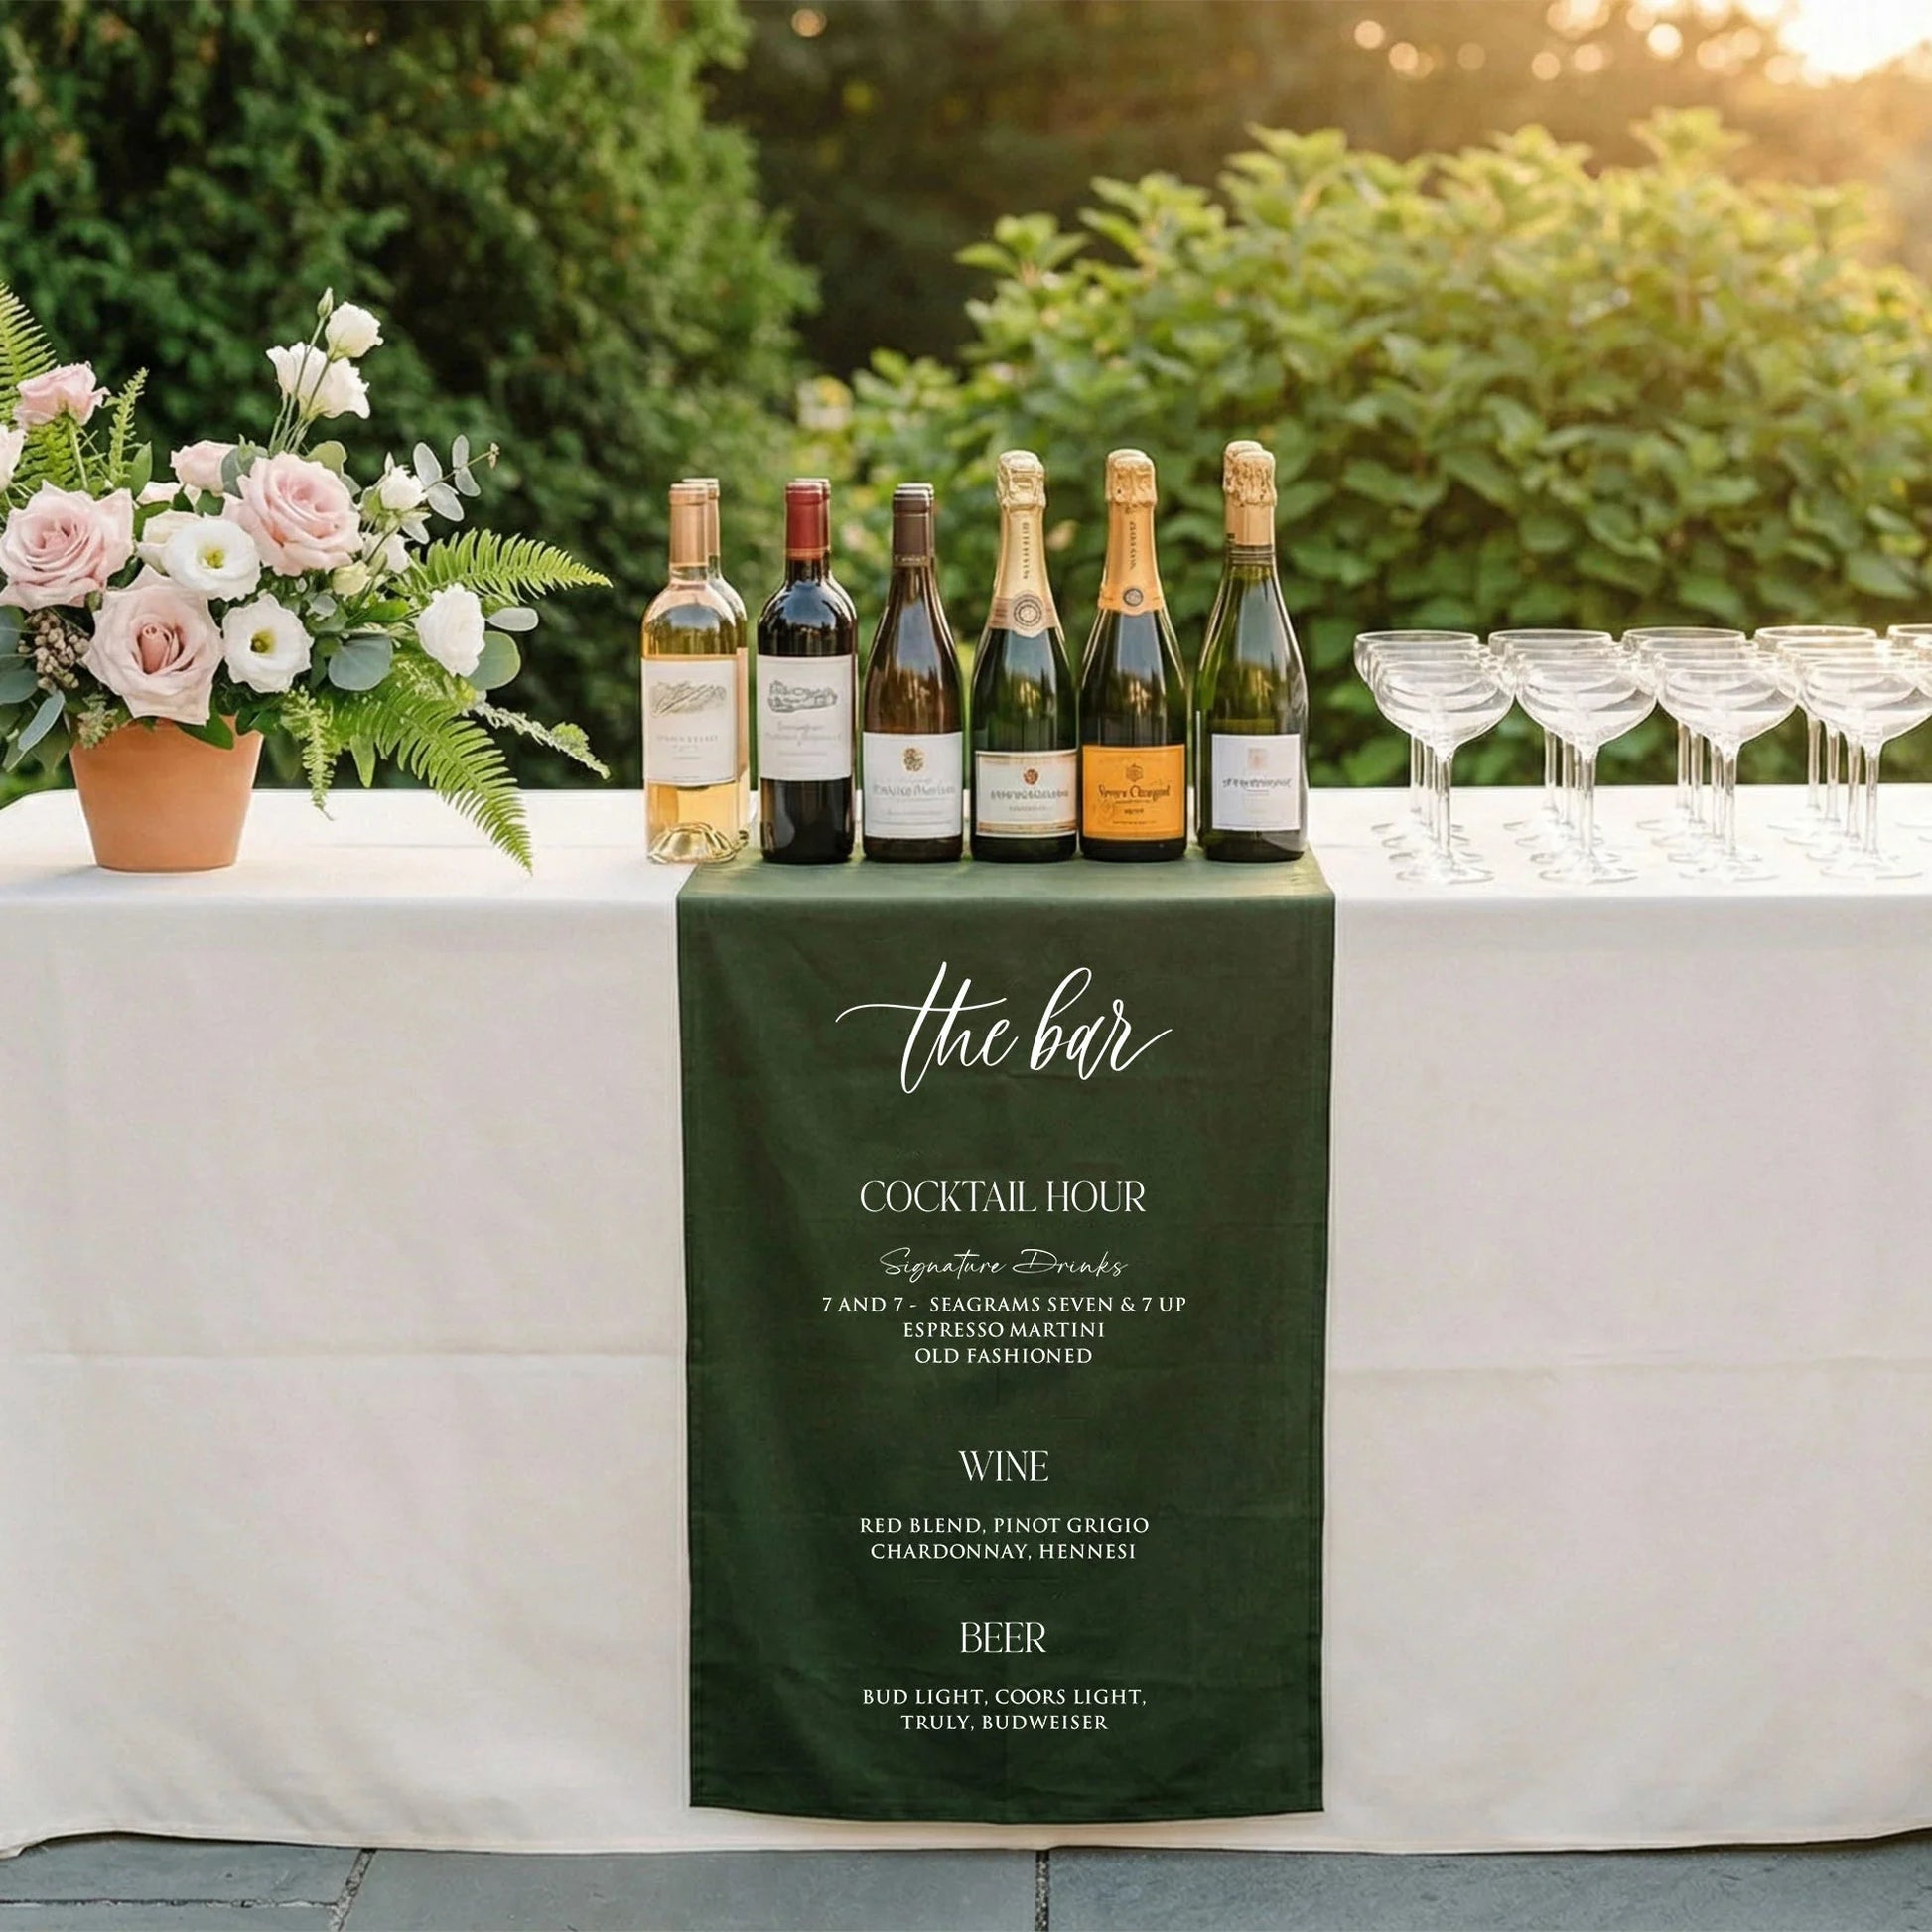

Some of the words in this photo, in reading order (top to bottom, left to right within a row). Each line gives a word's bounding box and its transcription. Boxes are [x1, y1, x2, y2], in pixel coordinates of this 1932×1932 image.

[835, 961, 1019, 1094] the
[1030, 967, 1173, 1080] bar
[861, 1181, 1036, 1212] COCKTAIL
[1047, 1181, 1146, 1212] HOUR
[880, 1247, 1007, 1283] Signature
[1013, 1249, 1129, 1278] Drinks
[822, 1297, 832, 1311] 7
[838, 1297, 886, 1311] AND
[894, 1297, 903, 1311] 7
[929, 1297, 1039, 1311] SEAGRAMS
[1047, 1297, 1112, 1311] SEVEN
[1121, 1297, 1136, 1311] &
[1143, 1297, 1152, 1311] 7
[1159, 1297, 1186, 1311] UP
[903, 1322, 1004, 1337] ESPRESSO
[1009, 1322, 1105, 1337] MARTINI
[915, 1348, 959, 1363] OLD
[967, 1348, 1092, 1363] FASHIONED
[958, 1450, 1049, 1481] WINE
[860, 1518, 901, 1533] RED
[910, 1518, 986, 1535] BLEND,
[995, 1518, 1060, 1533] PINOT
[1067, 1518, 1149, 1533] GRIGIO
[871, 1544, 1031, 1561] CHARDONNAY,
[1039, 1544, 1135, 1559] HENNESI
[960, 1622, 1047, 1652] BEER
[863, 1689, 907, 1705] BUD
[915, 1689, 988, 1706] LIGHT,
[995, 1689, 1065, 1705] COORS
[1073, 1689, 1147, 1706] LIGHT,
[901, 1715, 974, 1732] TRULY,
[982, 1715, 1108, 1730] BUDWEISER
